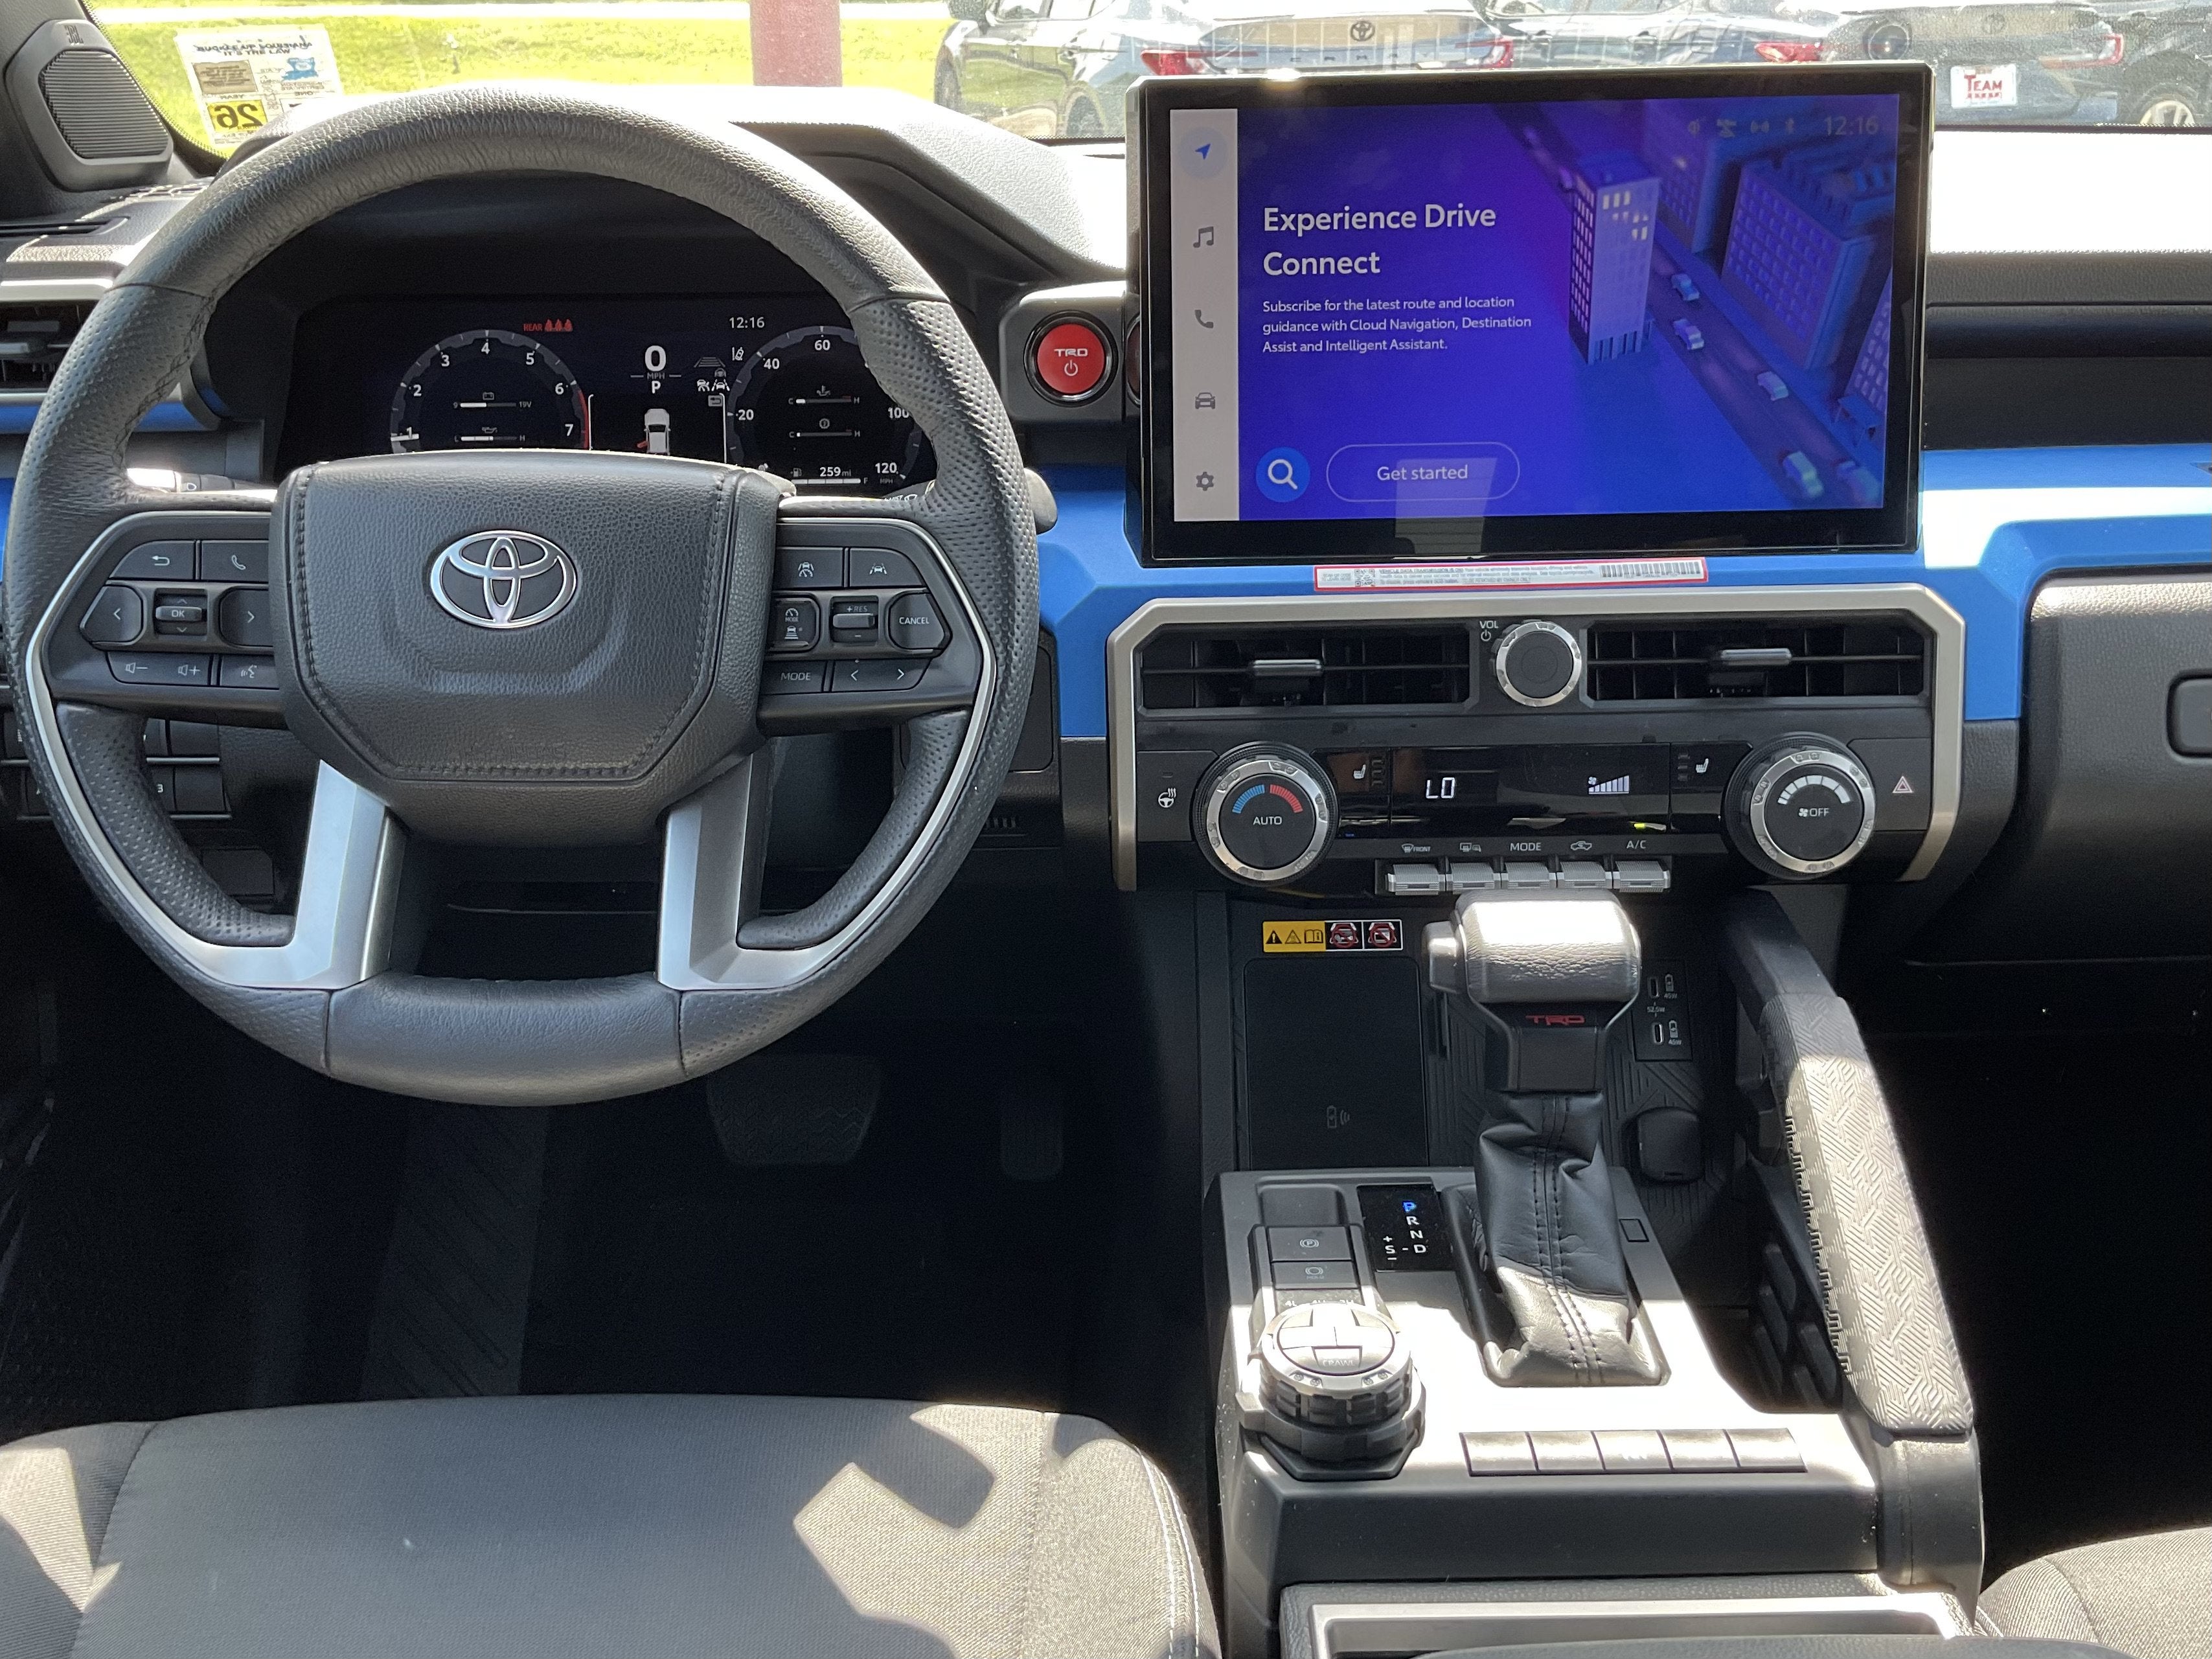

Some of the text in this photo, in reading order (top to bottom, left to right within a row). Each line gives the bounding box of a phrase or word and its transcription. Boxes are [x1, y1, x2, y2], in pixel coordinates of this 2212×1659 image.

[1963, 74, 2003, 91] TEAM
[1824, 116, 1879, 135] 12:16
[1264, 203, 1496, 236] Experience Drive
[1263, 251, 1381, 276] Connect
[1263, 297, 1514, 312] Subscribe for the latest route and location
[523, 323, 543, 332] REAR
[729, 317, 765, 329] 12:16
[1262, 316, 1531, 335] guidance with Cloud Navigation, Destination
[481, 342, 490, 354] 4
[814, 339, 831, 352] 60
[1263, 338, 1448, 354] Assist and Intelligent Assistant.
[644, 345, 667, 372] 0
[1054, 348, 1089, 357] TRD
[441, 354, 450, 367] 3
[525, 353, 534, 365] 5
[763, 358, 781, 370] 40
[413, 385, 422, 396] 2
[555, 382, 564, 395] 6
[651, 381, 661, 394] P
[738, 409, 754, 422] 20
[887, 407, 909, 419] 100
[406, 426, 413, 439] 1
[565, 424, 574, 436] 7
[819, 466, 841, 477] 259
[875, 462, 897, 474] 120
[1377, 464, 1468, 481] Get started
[171, 610, 185, 618] OK
[899, 617, 929, 625] CANCEL
[1479, 621, 1499, 630] VOL
[781, 672, 811, 681] MODE
[1426, 777, 1455, 799] LO
[1809, 808, 1829, 817] OFF
[1253, 816, 1283, 825] AUTO
[1510, 842, 1542, 851] MODE
[1626, 840, 1647, 849] A/C
[1525, 1015, 1585, 1025] TRD
[1402, 1202, 1417, 1212] P
[1406, 1216, 1420, 1225] R
[1409, 1230, 1423, 1239] N
[1385, 1244, 1426, 1253] S D
